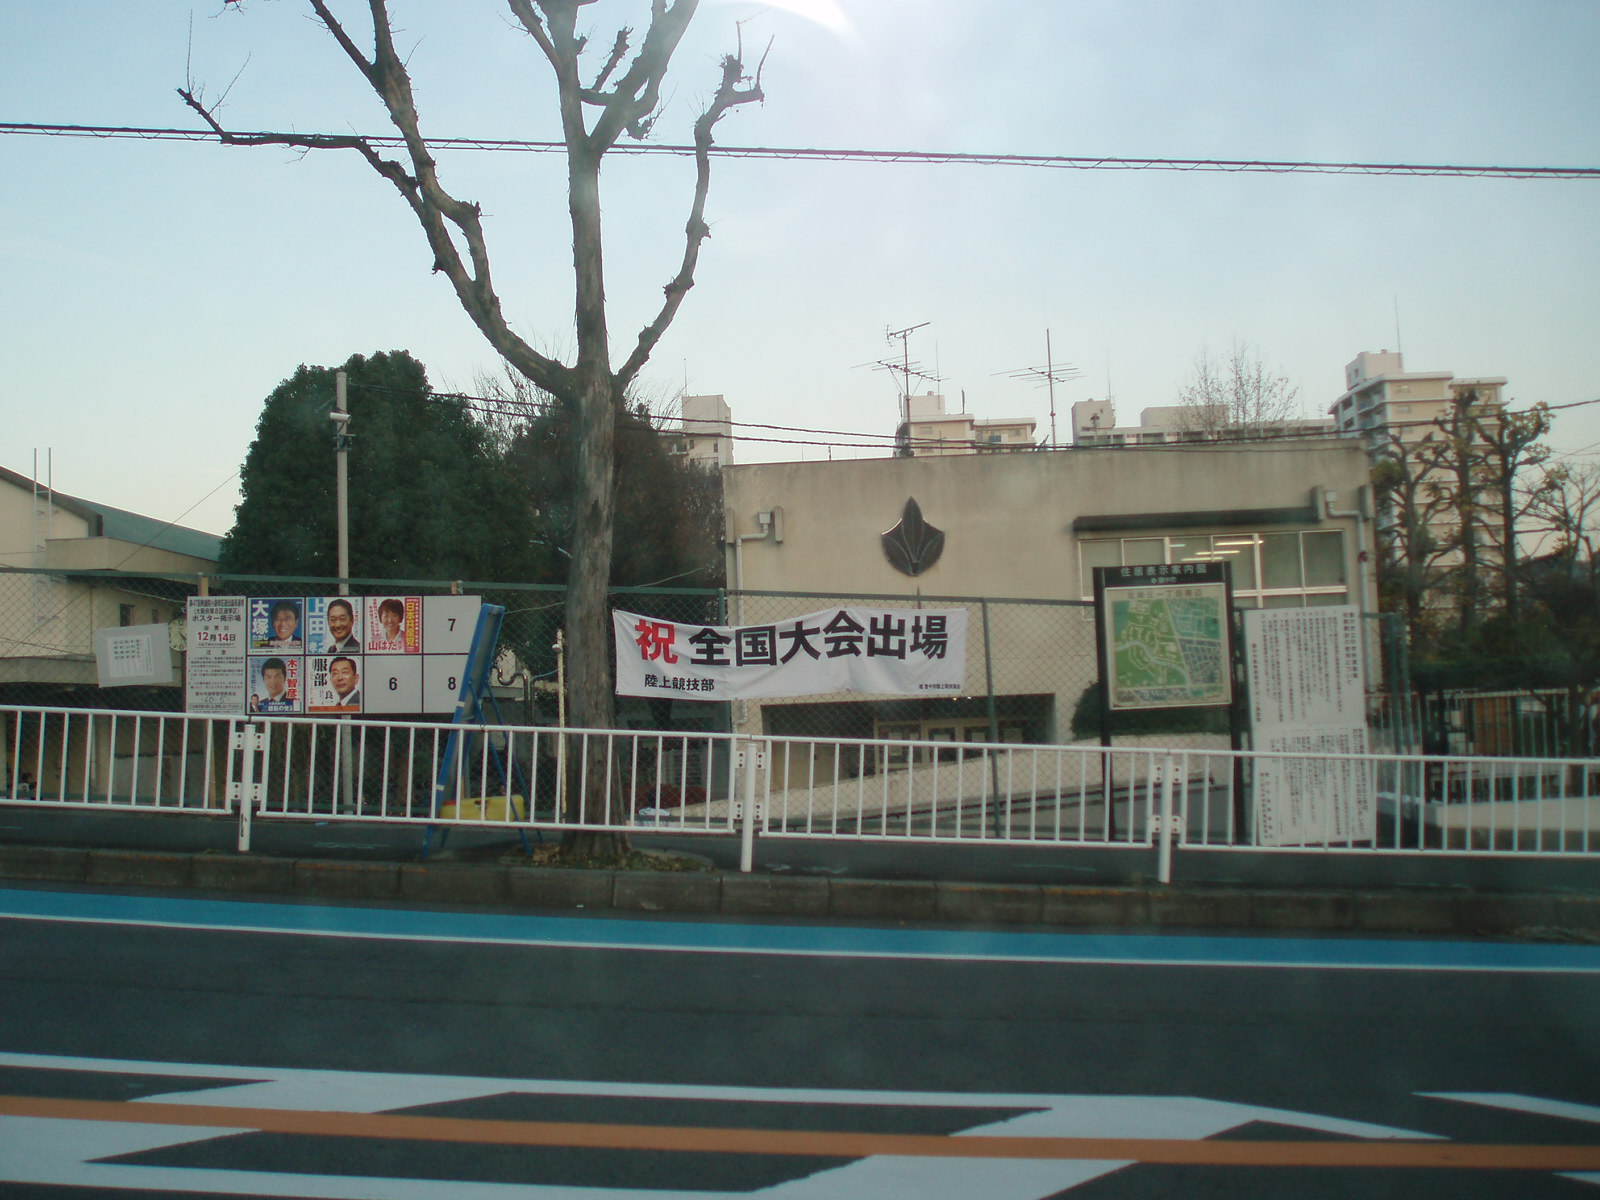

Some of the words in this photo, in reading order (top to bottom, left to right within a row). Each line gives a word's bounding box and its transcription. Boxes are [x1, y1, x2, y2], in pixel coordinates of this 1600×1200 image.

[192, 614, 241, 622] ポスター掲示場
[447, 618, 457, 632] 7
[197, 631, 236, 642] 12月14日
[634, 618, 679, 665] 祝
[688, 609, 948, 667] 全国大会出場
[368, 640, 398, 651] 山はた
[313, 658, 328, 687] 服部
[388, 677, 398, 691] 6
[447, 676, 457, 691] 8
[644, 673, 715, 692] 陸上競技部
